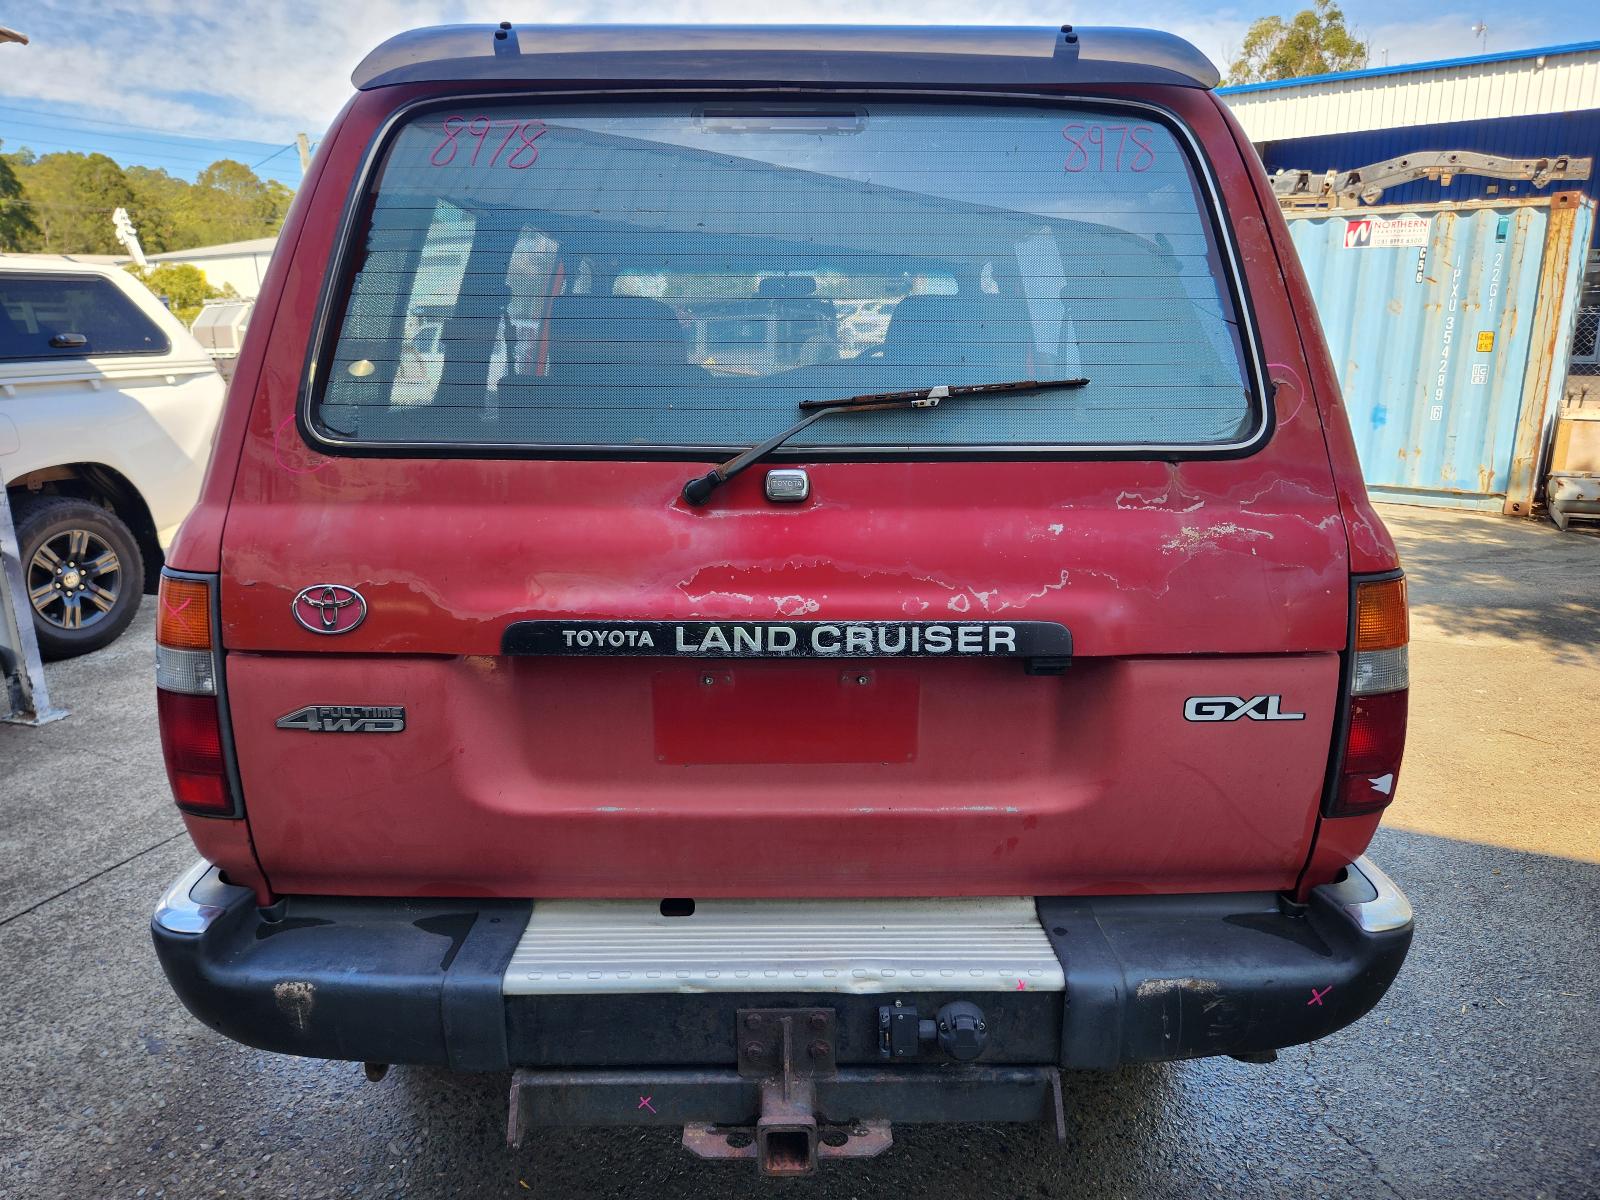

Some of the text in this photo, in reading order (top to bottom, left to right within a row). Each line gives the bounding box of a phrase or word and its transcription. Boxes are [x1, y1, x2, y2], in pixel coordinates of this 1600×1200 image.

[431, 115, 548, 169] 8978
[1063, 122, 1155, 173] 8978
[1374, 220, 1427, 228] NORTHERN
[1416, 247, 1427, 283] C56
[1489, 253, 1503, 312] 22G1
[562, 626, 1016, 652] TOYOTA LAND CRUISER
[1184, 695, 1305, 721] GXL
